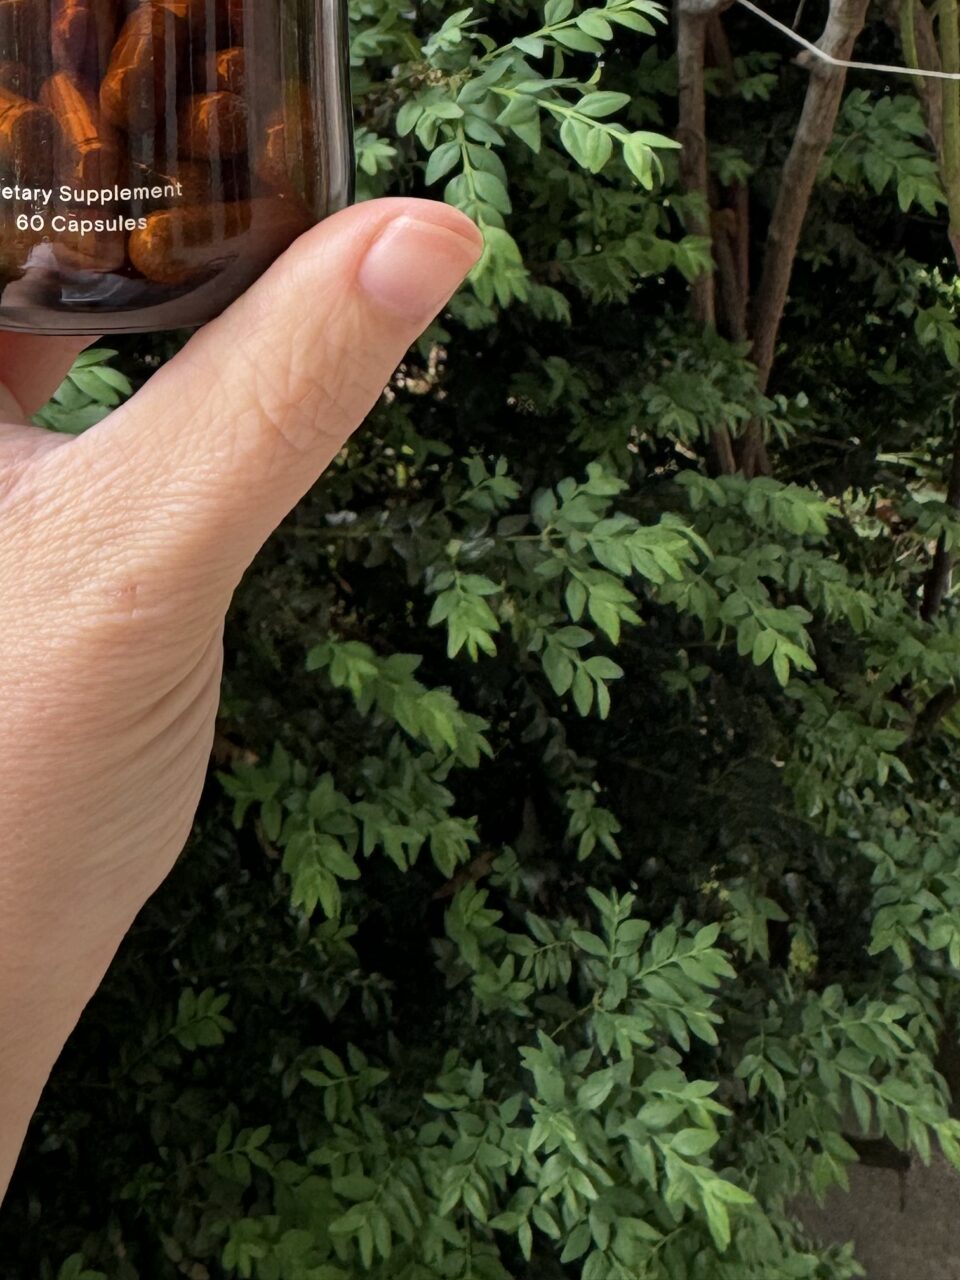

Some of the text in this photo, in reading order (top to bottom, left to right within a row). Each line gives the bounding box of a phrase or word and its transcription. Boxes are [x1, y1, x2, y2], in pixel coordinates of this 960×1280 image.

[59, 182, 183, 205] Supplement
[16, 214, 148, 236] 60 Capsules
